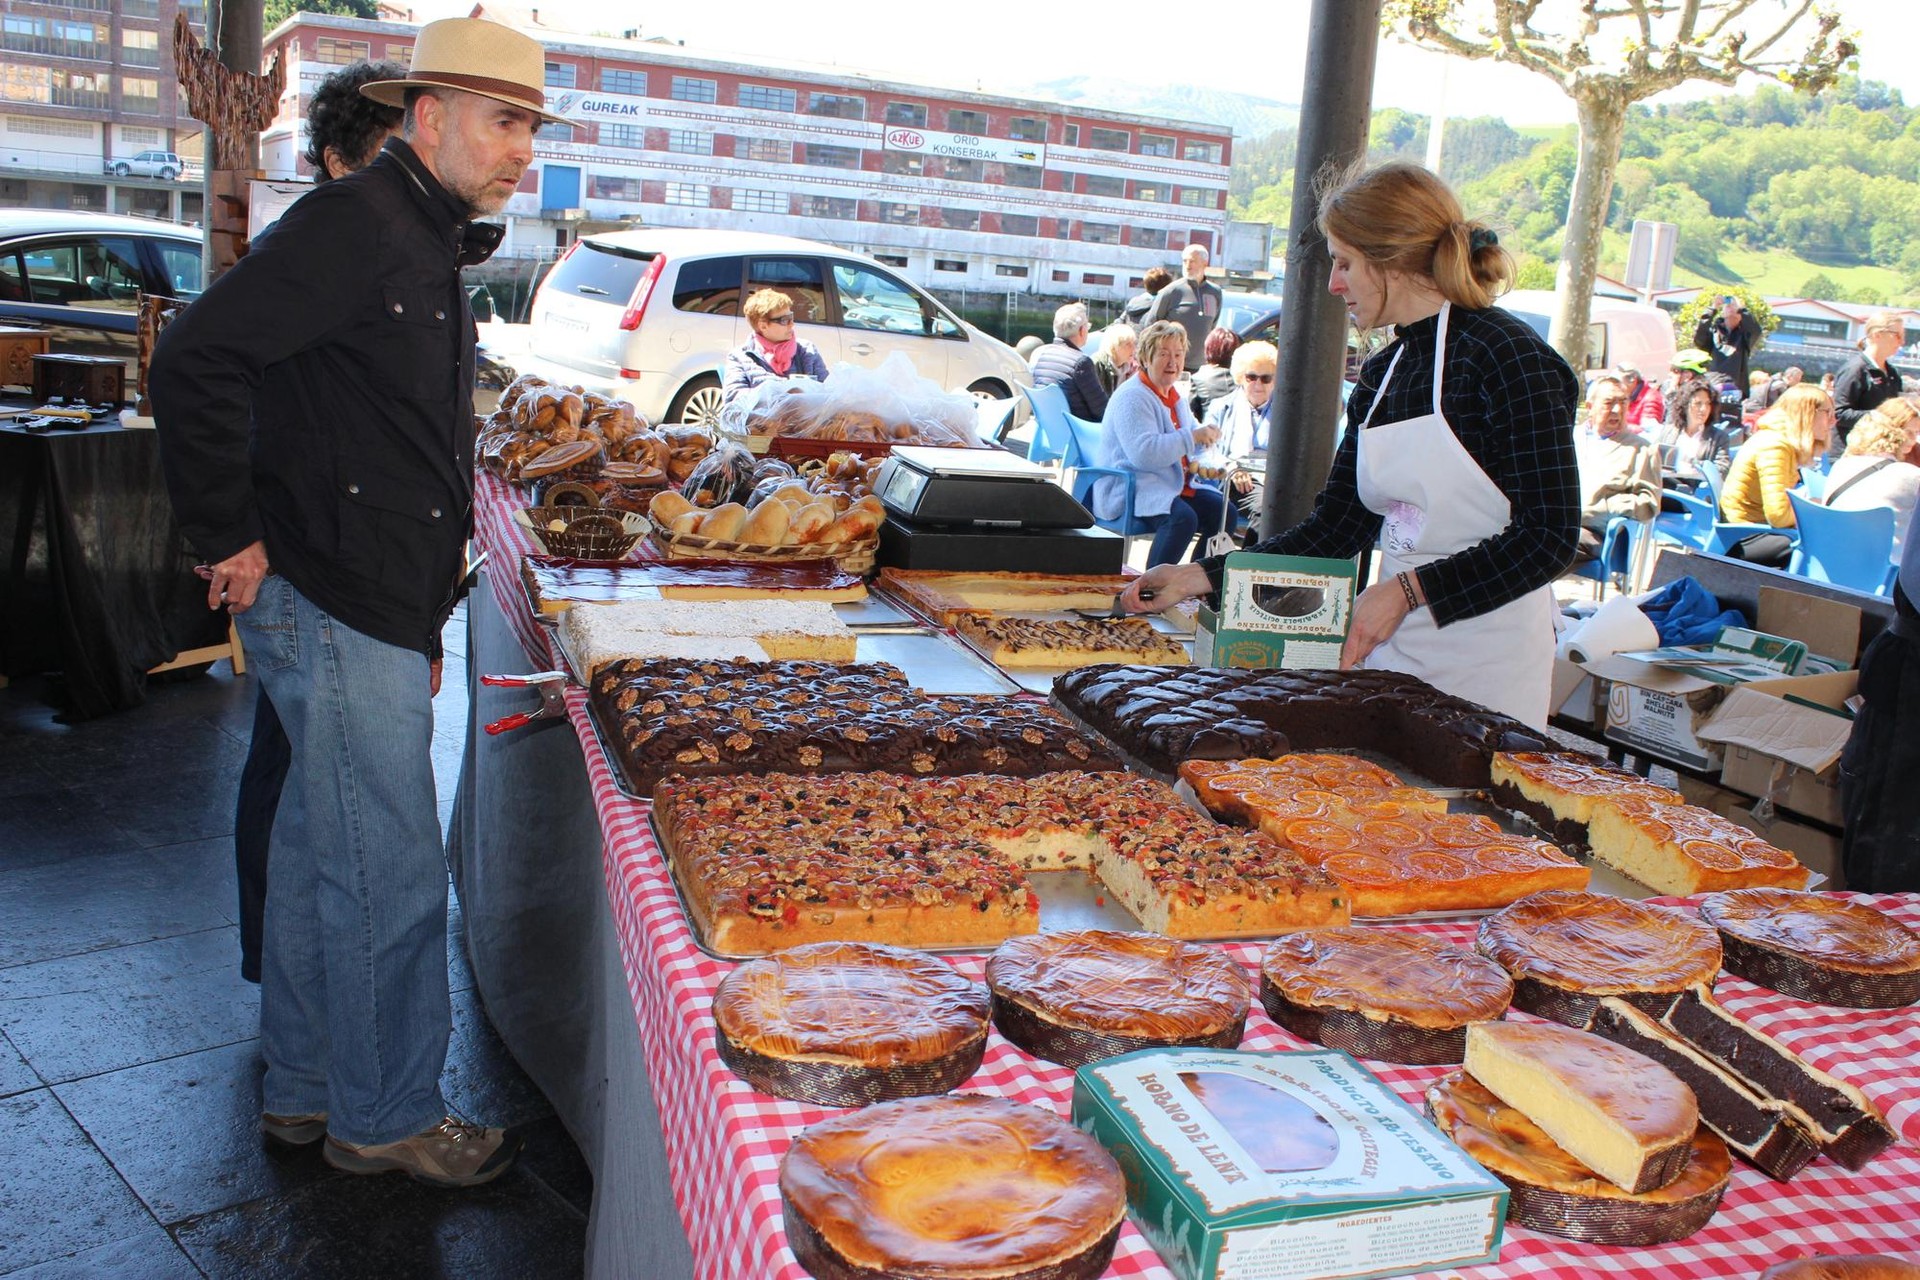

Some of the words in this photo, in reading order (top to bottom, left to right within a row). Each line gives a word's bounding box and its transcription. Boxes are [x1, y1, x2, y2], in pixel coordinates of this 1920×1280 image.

[582, 100, 639, 115] GUREAK
[891, 132, 920, 146] AZKUE
[953, 134, 979, 146] ORIO
[933, 144, 997, 160] KONSERBAK
[1643, 703, 1675, 720] WALNUTS
[1645, 698, 1675, 713] SHELLED
[1136, 1072, 1190, 1122] HORNO
[1178, 1122, 1210, 1143] DE
[1309, 1058, 1380, 1115] PRODUCTO
[1373, 1115, 1455, 1180] ARTESANO
[1337, 1215, 1392, 1229] INGREDIENTES
